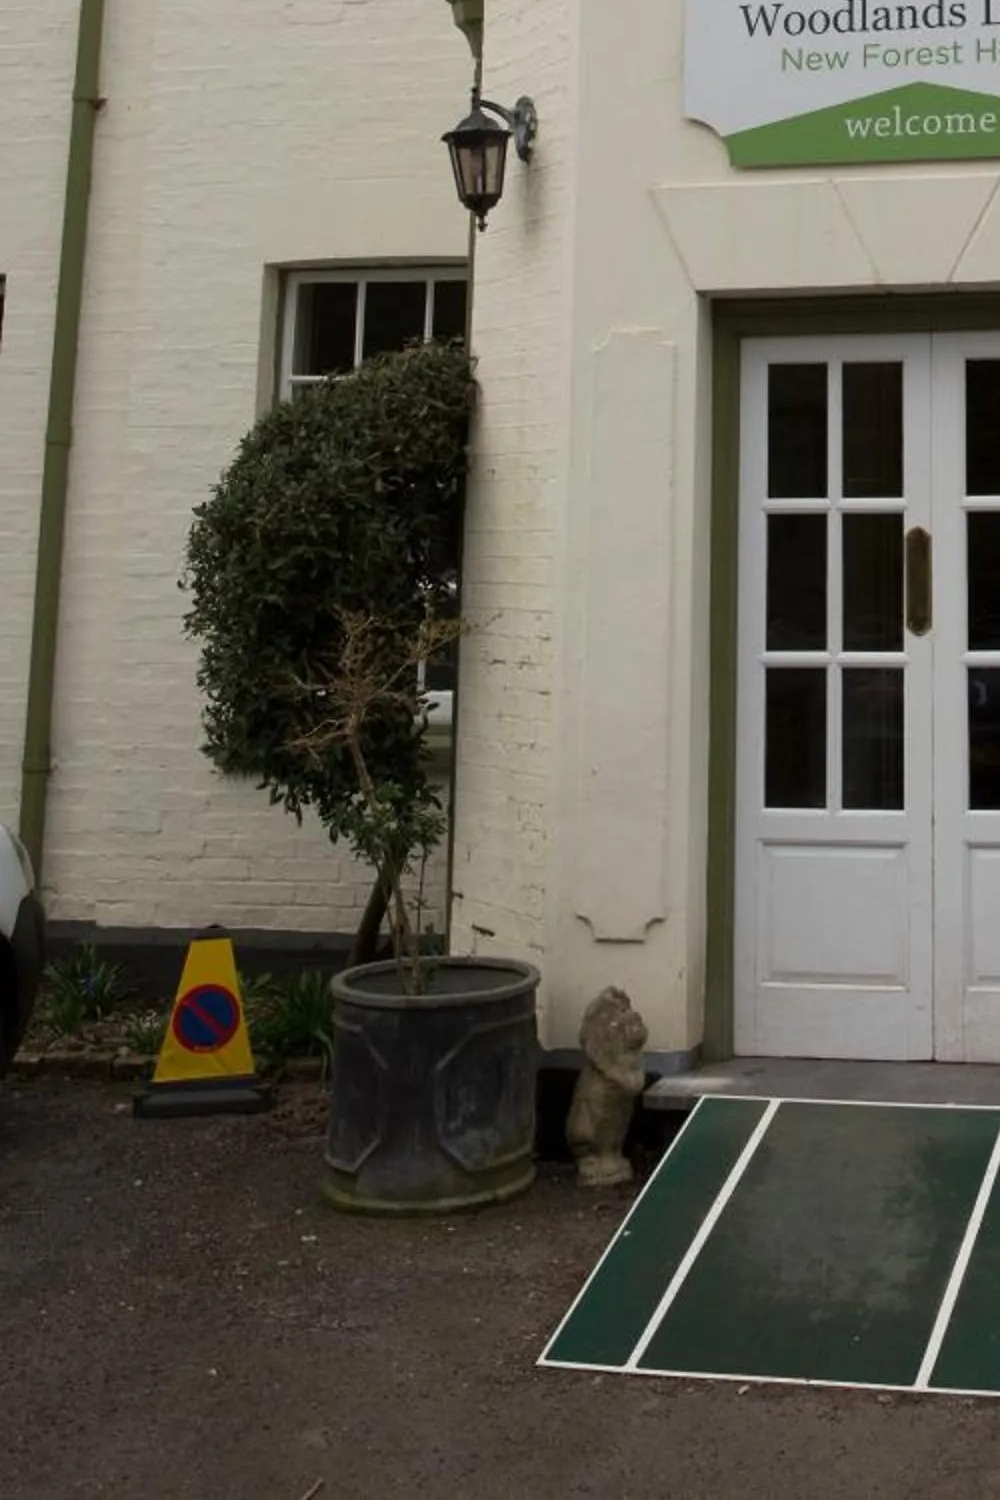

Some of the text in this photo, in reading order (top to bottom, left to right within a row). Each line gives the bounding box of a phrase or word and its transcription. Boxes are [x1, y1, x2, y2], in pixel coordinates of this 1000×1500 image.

[780, 46, 850, 72] New
[862, 40, 963, 69] Forest
[845, 106, 998, 138] welcome
